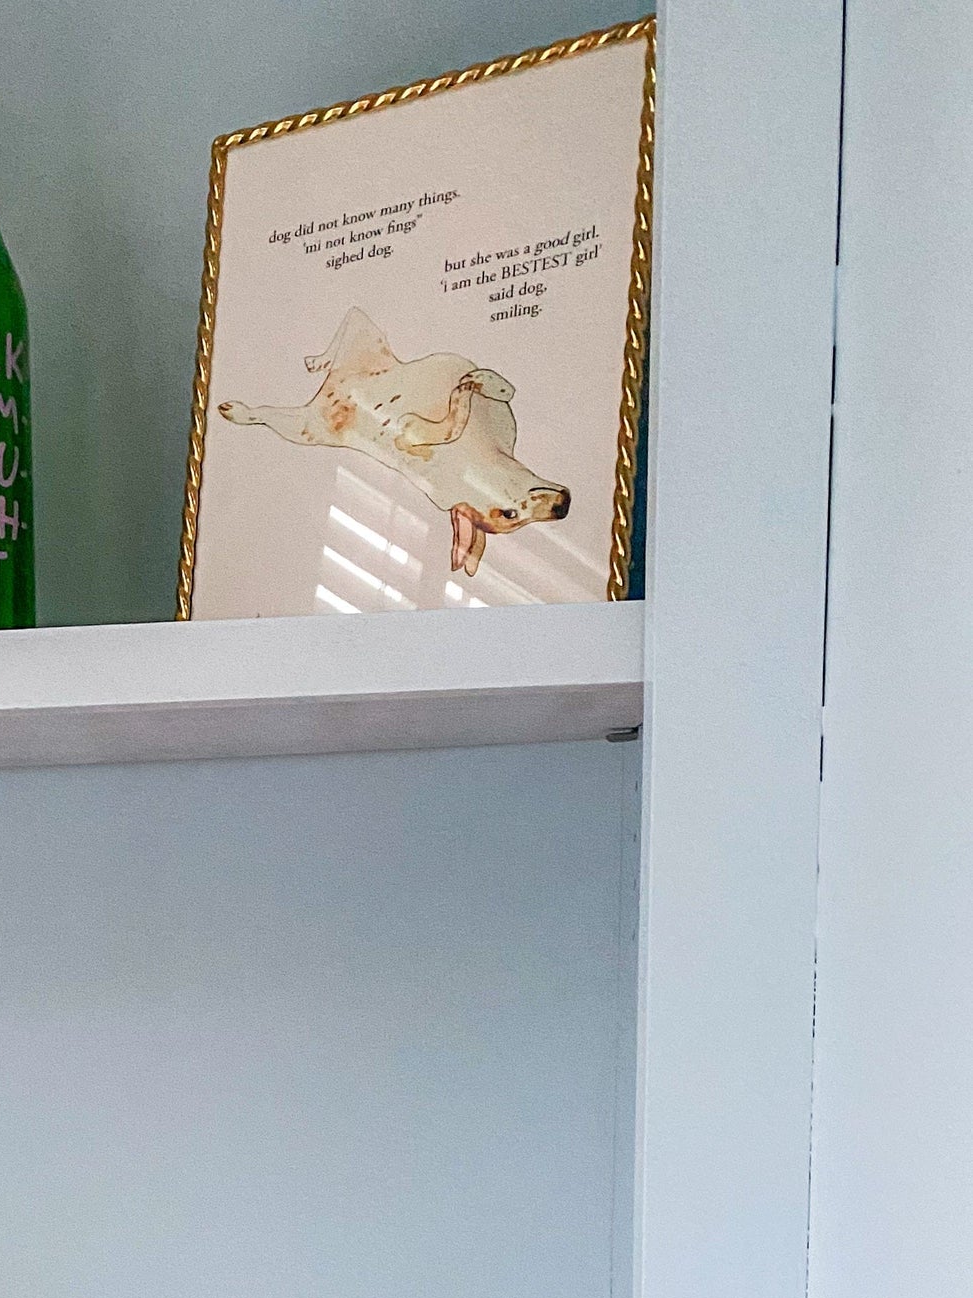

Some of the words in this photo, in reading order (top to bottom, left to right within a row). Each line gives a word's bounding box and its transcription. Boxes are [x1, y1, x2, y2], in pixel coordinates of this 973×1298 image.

[268, 230, 291, 244] dog
[294, 221, 314, 238] did
[318, 219, 339, 232] not
[342, 212, 376, 227] know
[379, 199, 415, 217] many
[418, 189, 461, 207] things.
[325, 238, 345, 250] not
[349, 227, 384, 244] know
[444, 258, 467, 273] but
[470, 251, 492, 267] she
[495, 247, 520, 261] was
[523, 244, 531, 255] a
[533, 230, 572, 256] good
[572, 224, 600, 248] girl.
[325, 248, 365, 270] sighed
[367, 244, 395, 259] dog.
[451, 278, 472, 291] am
[476, 270, 497, 286] the
[501, 251, 573, 280] BESTEST
[488, 284, 515, 303] said
[489, 303, 543, 322] smiling.
